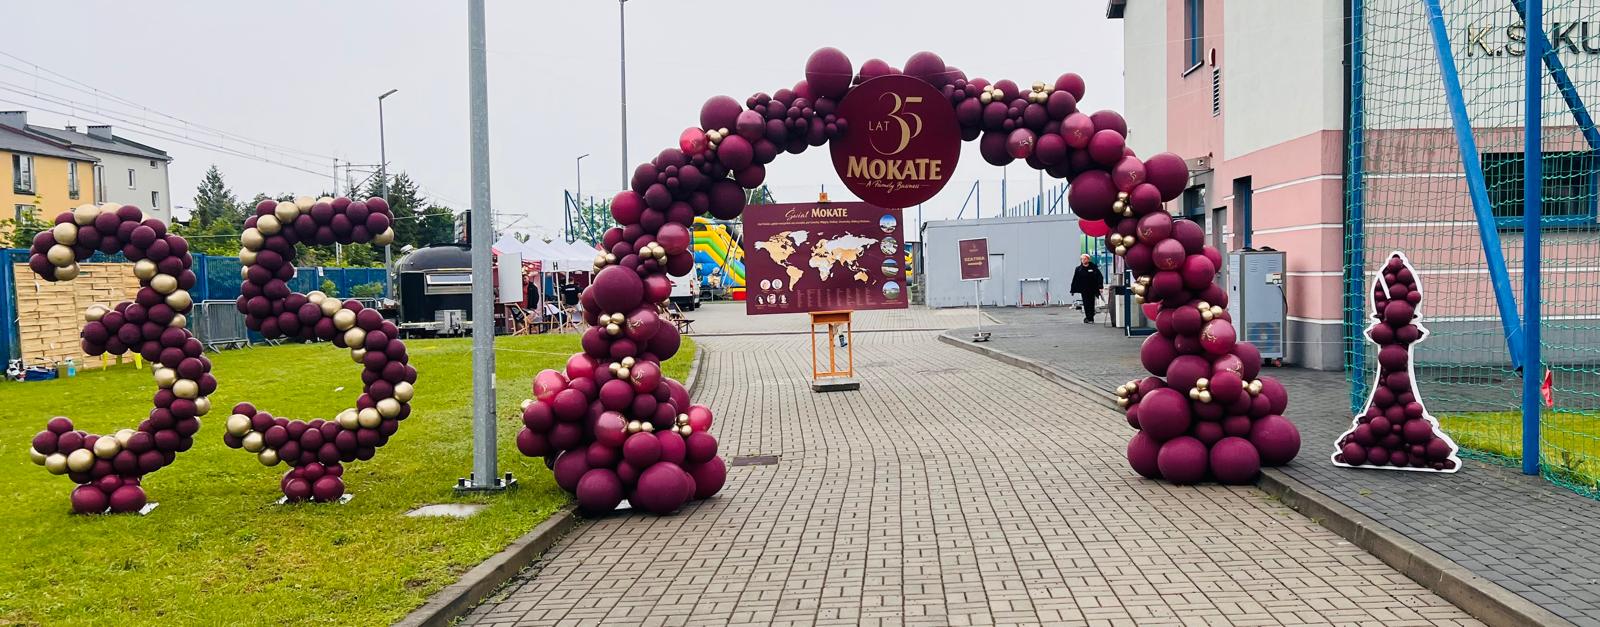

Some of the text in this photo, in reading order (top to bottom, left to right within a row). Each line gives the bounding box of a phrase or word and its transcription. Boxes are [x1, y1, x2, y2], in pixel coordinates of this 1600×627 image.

[868, 120, 890, 131] LAT
[869, 91, 923, 155] 35
[846, 156, 942, 180] MOKATE
[811, 208, 848, 218] MOKATE
